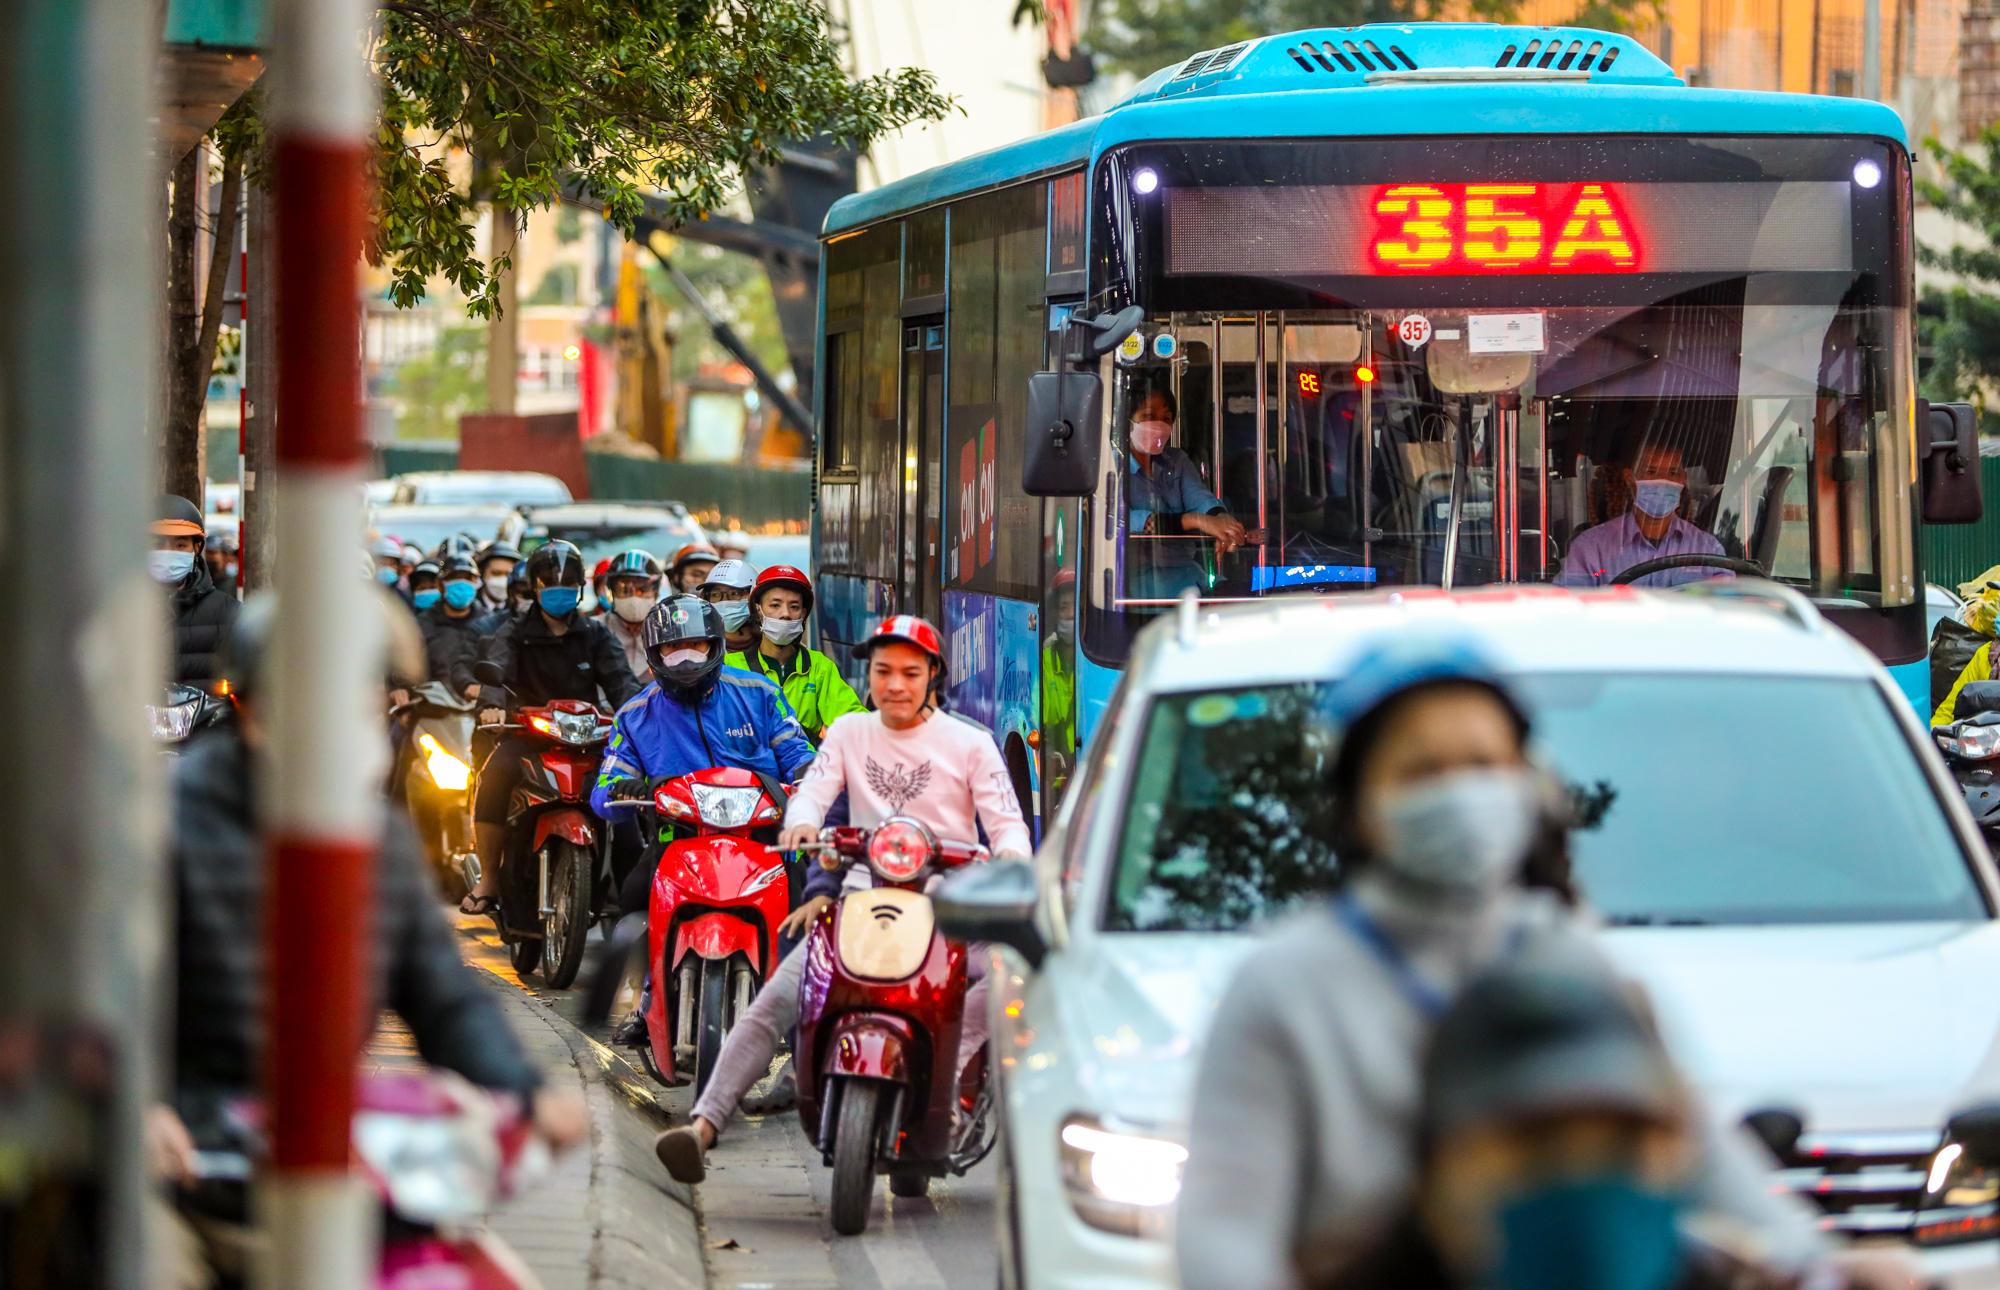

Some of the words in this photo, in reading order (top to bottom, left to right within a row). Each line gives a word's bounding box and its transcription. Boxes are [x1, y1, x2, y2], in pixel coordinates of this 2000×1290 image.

[1377, 185, 1635, 267] 35A
[1403, 321, 1429, 341] 35A
[973, 596, 986, 675] PHÍ
[709, 838, 739, 847] HONDA
